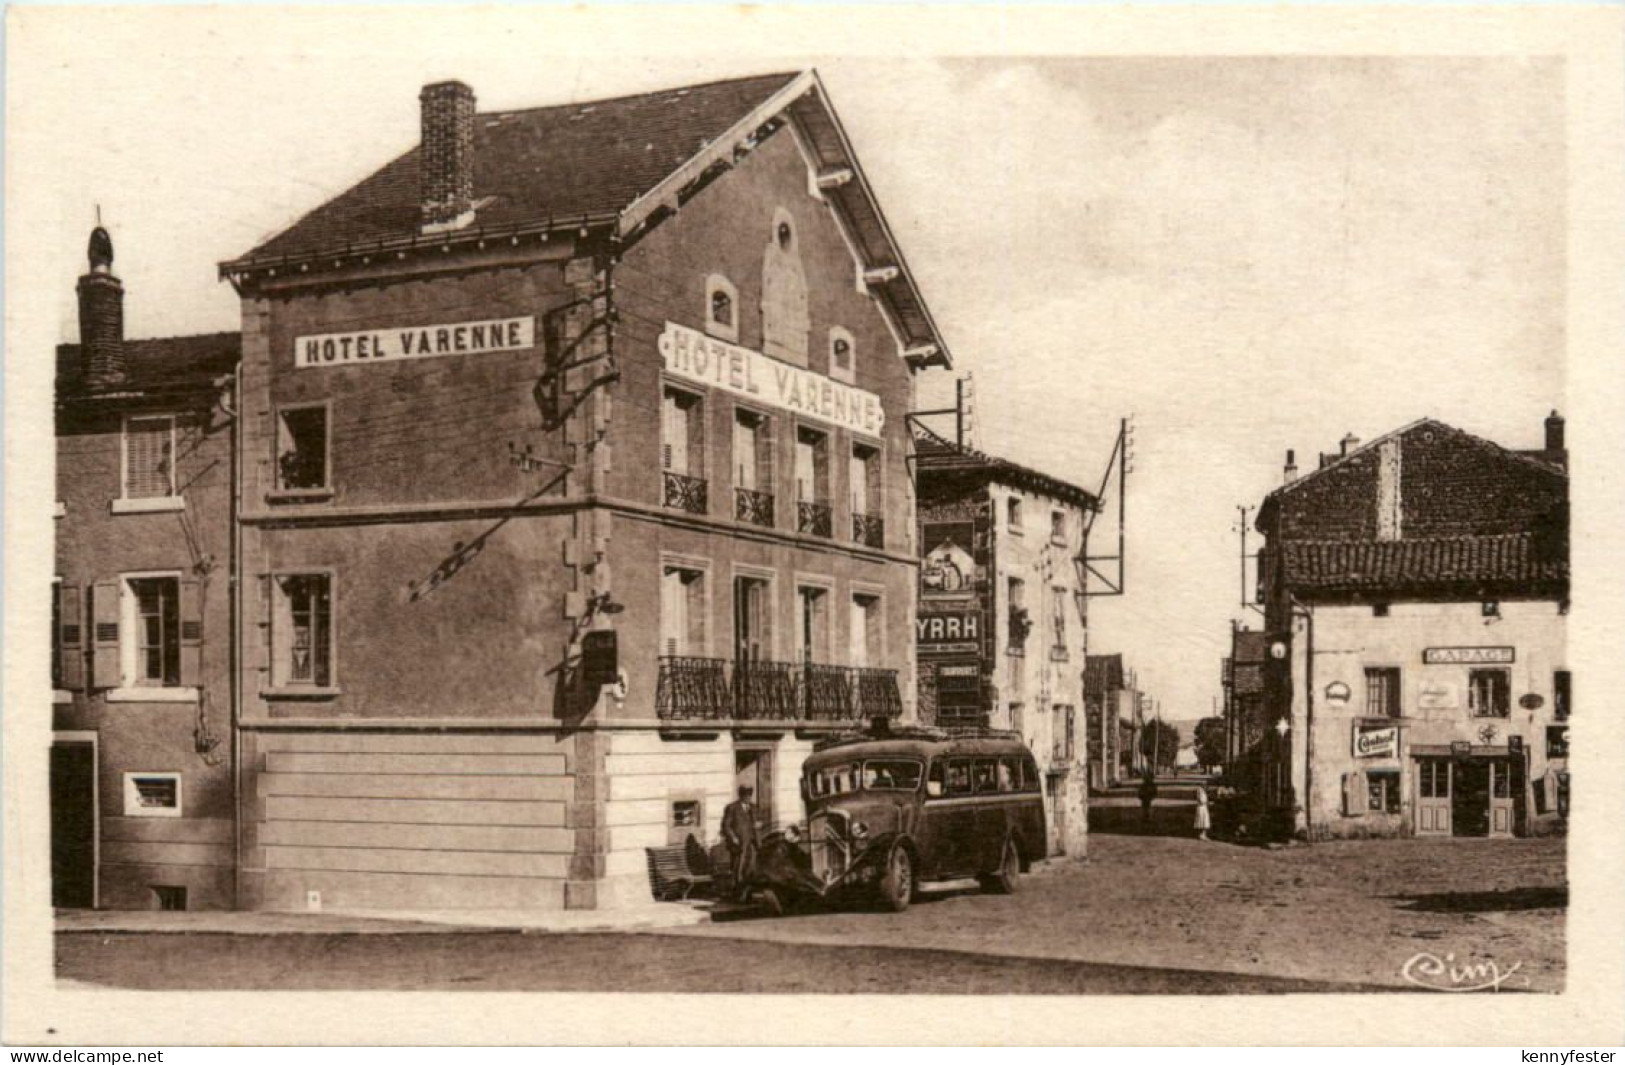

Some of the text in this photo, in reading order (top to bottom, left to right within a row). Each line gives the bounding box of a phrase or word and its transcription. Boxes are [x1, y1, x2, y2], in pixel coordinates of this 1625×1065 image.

[305, 322, 522, 363] HOTEL VARENNE
[673, 330, 874, 431] HOTEL VARENNE
[915, 615, 978, 640] YRRH
[1428, 648, 1512, 662] GARAGE
